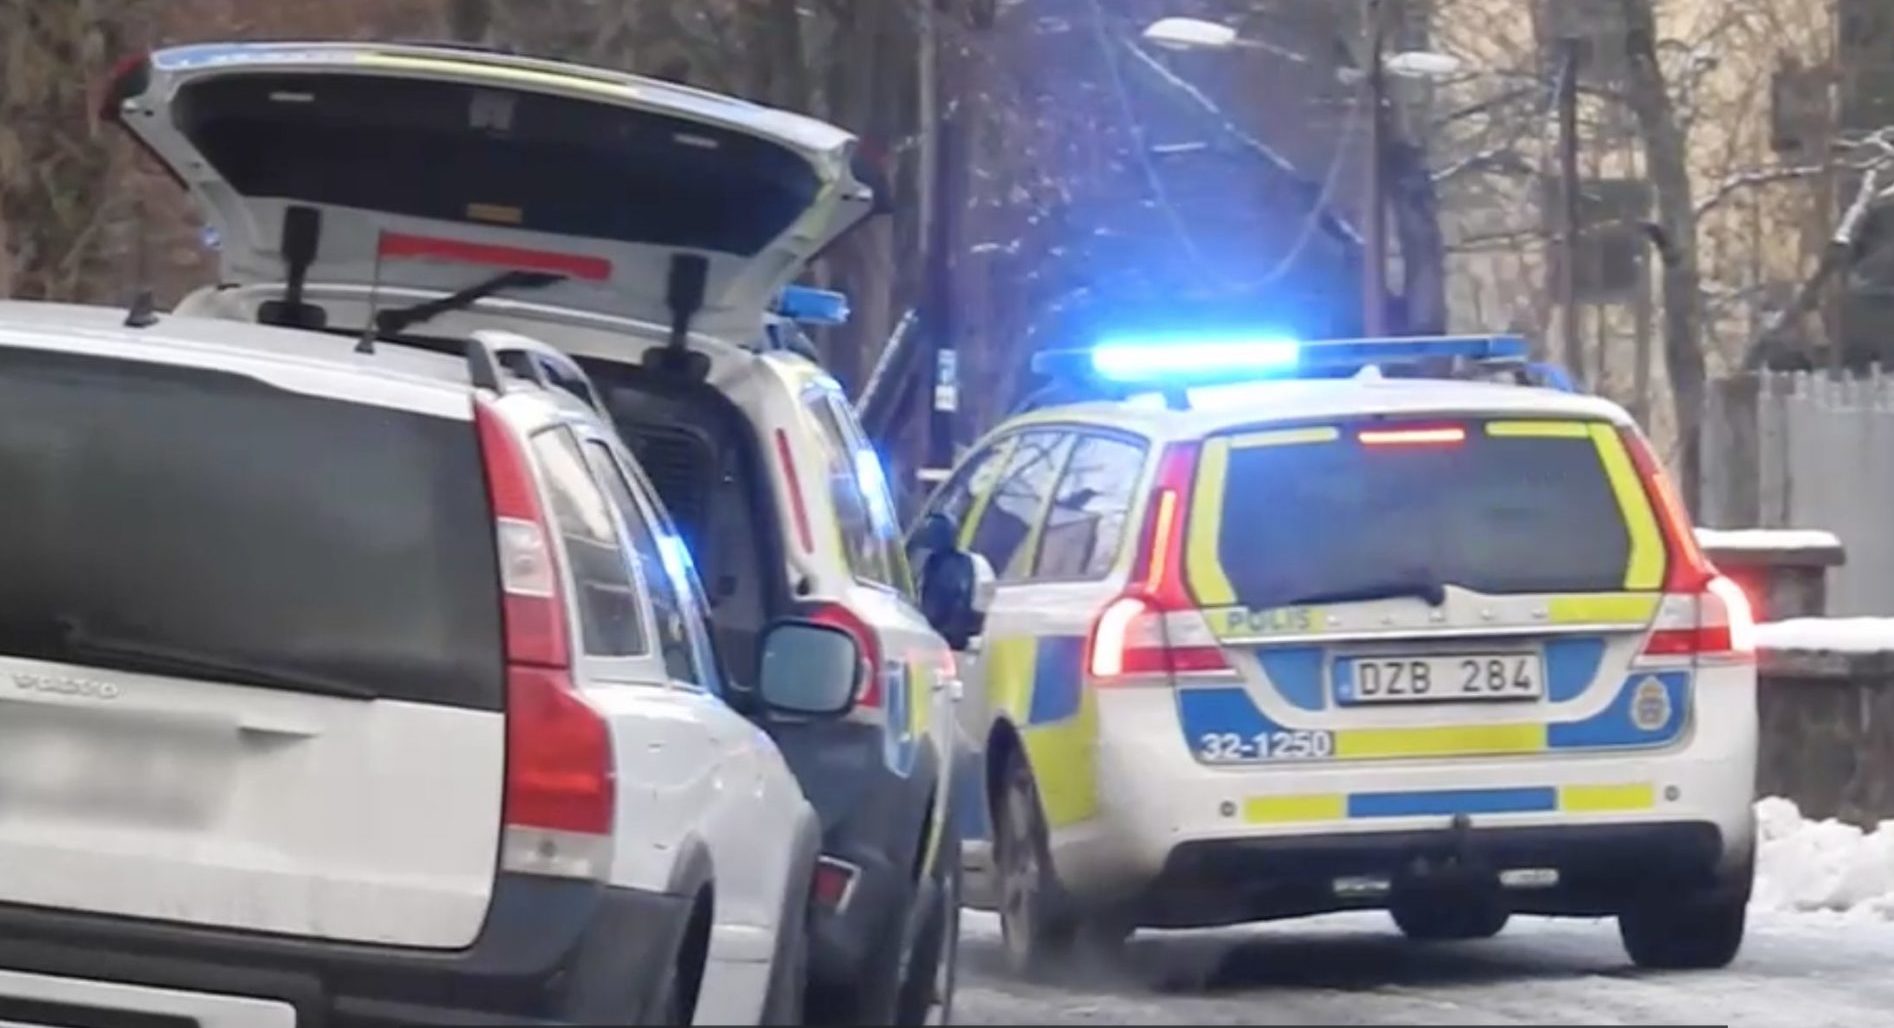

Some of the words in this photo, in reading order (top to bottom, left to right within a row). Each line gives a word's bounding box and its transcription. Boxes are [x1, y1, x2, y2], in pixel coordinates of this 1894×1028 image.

[1227, 606, 1310, 631] POLIS
[1360, 660, 1431, 695] DZB
[1461, 659, 1531, 693] 284
[1201, 730, 1332, 760] 32-1250
